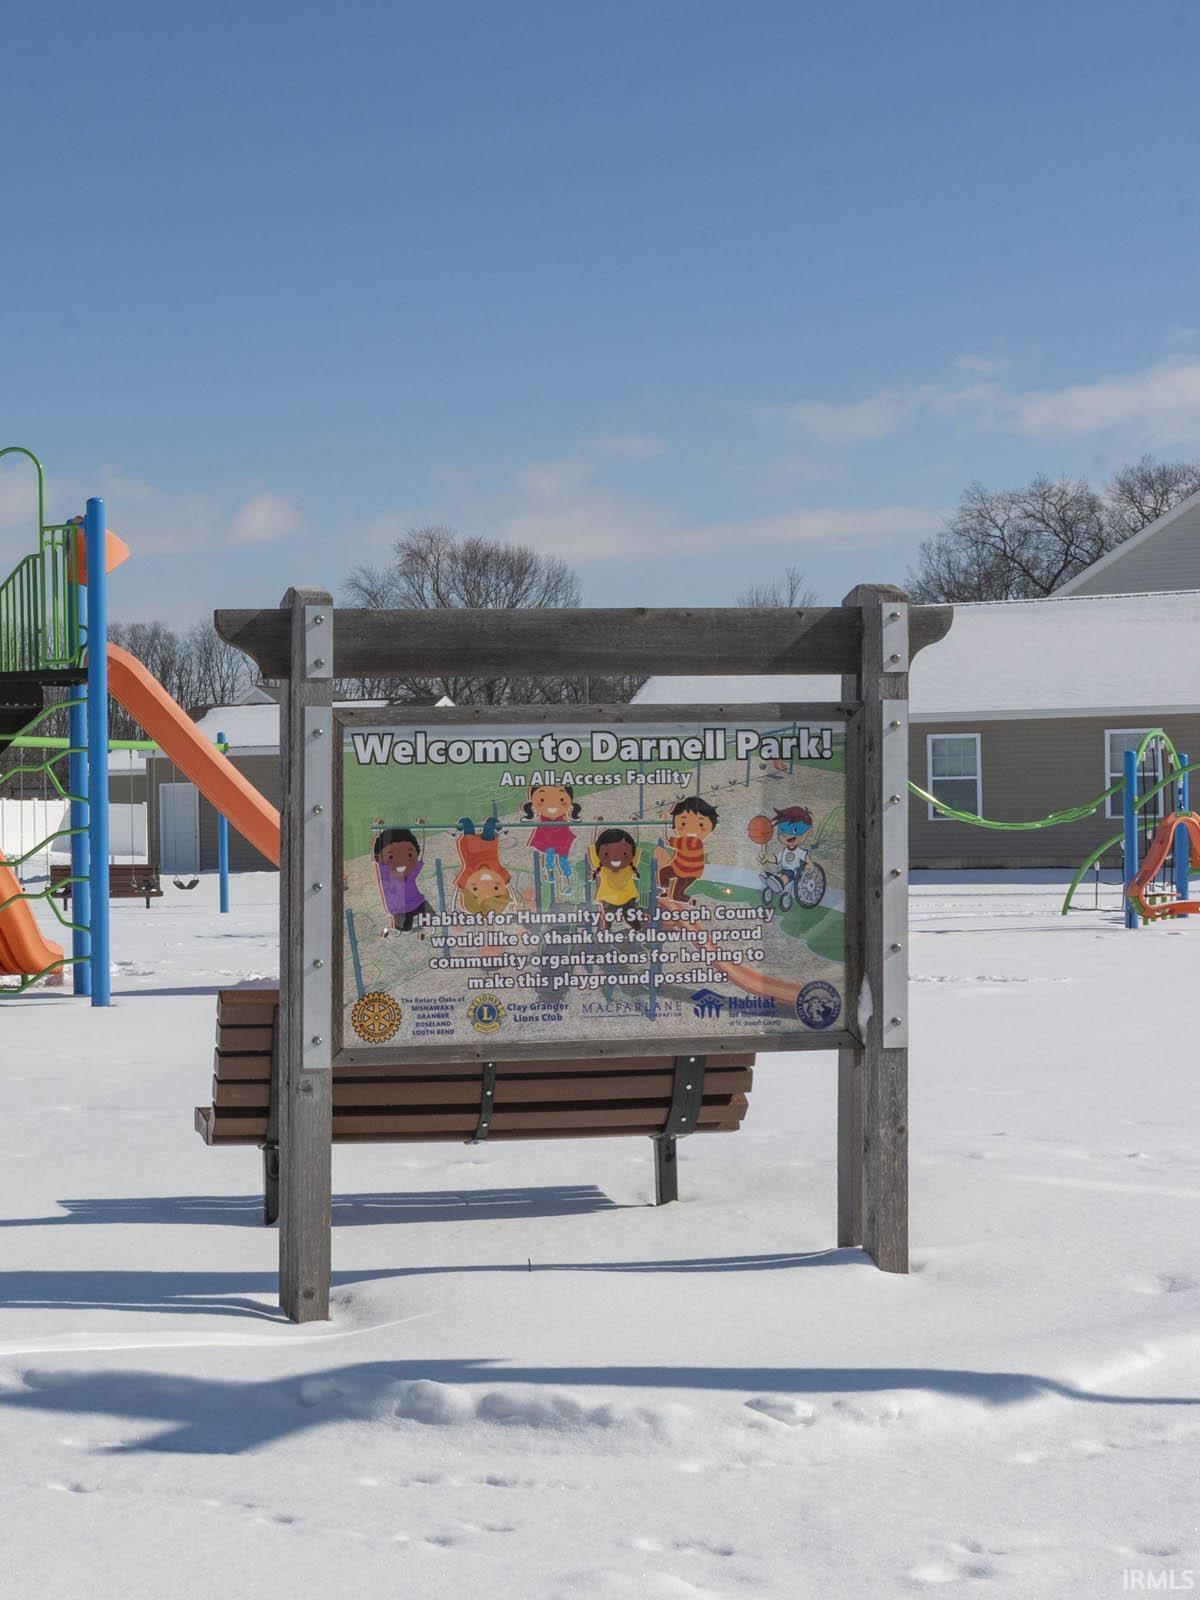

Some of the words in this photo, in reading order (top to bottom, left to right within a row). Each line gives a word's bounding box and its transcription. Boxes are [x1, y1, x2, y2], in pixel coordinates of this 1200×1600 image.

[351, 731, 532, 764] Welcome
[539, 733, 582, 763] to
[590, 728, 726, 762] Darnell
[736, 727, 833, 760] Park!
[500, 771, 526, 787] An
[530, 769, 622, 786] All-Access
[626, 768, 692, 787] Facility
[418, 910, 484, 927] Habitat
[487, 910, 513, 925] for
[517, 909, 601, 926] Humanity
[604, 908, 623, 922] of
[626, 908, 649, 922] St.
[653, 907, 711, 924] Joseph
[715, 906, 775, 922] County
[431, 931, 484, 947] would
[487, 930, 518, 946] like
[521, 932, 540, 945] to
[544, 929, 593, 945] thank
[597, 929, 625, 943] the
[628, 928, 708, 944] following
[711, 926, 762, 943] proud
[429, 953, 528, 970] community
[531, 951, 647, 969] organizations
[651, 949, 677, 963] for
[681, 948, 743, 965] helping
[746, 949, 765, 961] to
[468, 974, 514, 989] make
[517, 973, 549, 988] this
[553, 970, 650, 990] playground
[654, 968, 728, 987] possible:
[414, 997, 437, 1005] Rotary
[507, 1003, 527, 1013] Clay
[530, 1002, 569, 1013] Granger
[728, 996, 776, 1009] Habitat
[513, 1014, 540, 1022] Lions
[541, 1013, 563, 1021] Club
[729, 1010, 739, 1018] for
